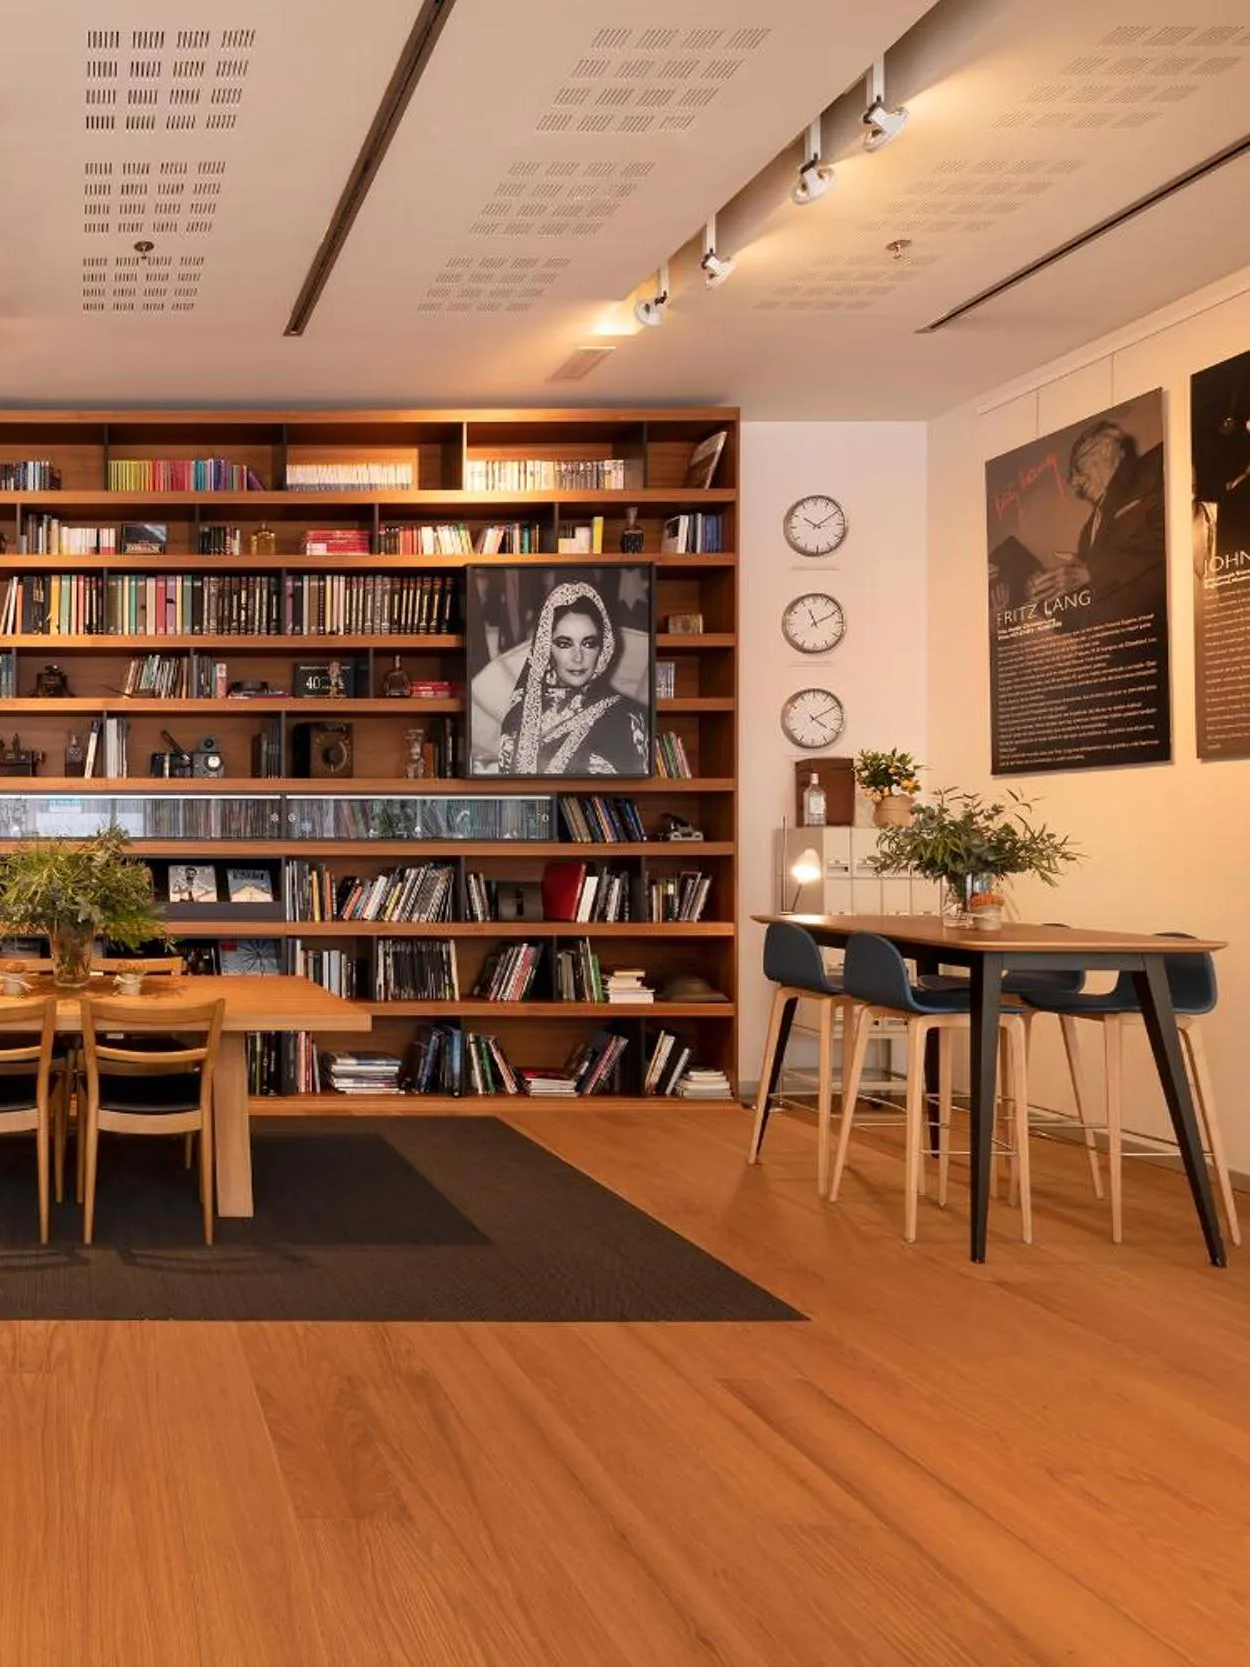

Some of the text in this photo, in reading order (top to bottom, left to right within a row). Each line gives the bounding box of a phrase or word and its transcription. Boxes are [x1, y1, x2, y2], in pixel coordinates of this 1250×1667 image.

[997, 603, 1038, 627] FRITZ
[1044, 589, 1091, 617] LANG
[305, 676, 321, 689] 40
